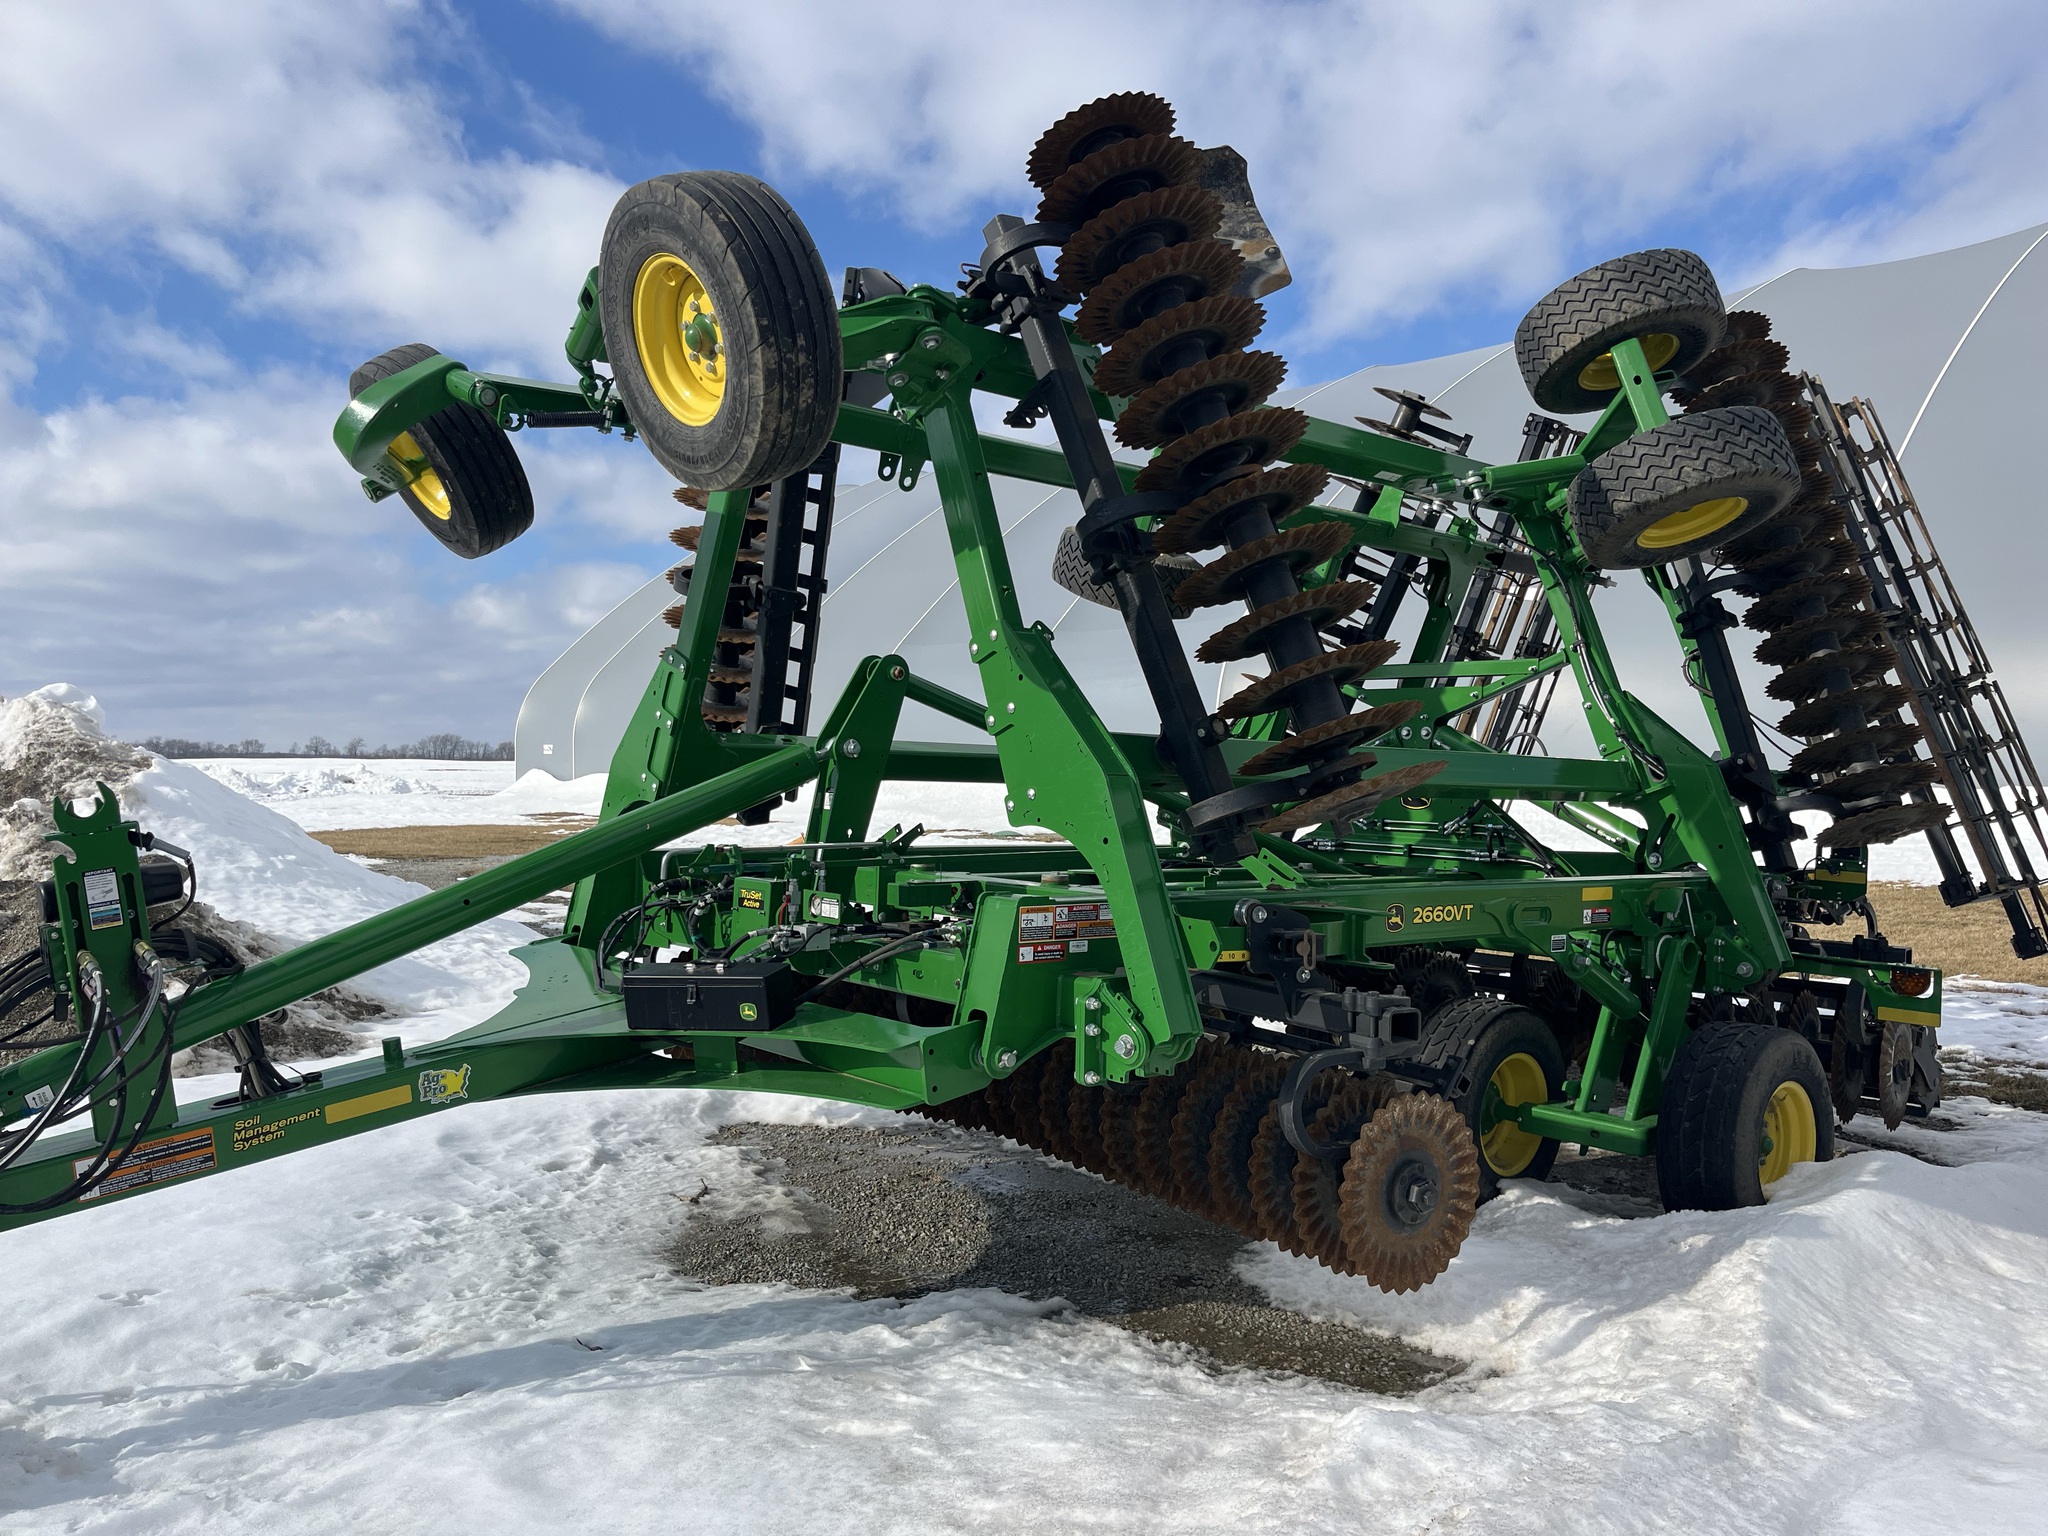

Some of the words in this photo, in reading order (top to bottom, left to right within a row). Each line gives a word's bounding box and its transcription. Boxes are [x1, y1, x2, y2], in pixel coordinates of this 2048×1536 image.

[84, 868, 114, 876] IMPORTANT
[741, 889, 762, 900] TruSet
[743, 899, 760, 909] Active
[1413, 904, 1474, 924] 2660VT
[422, 1073, 446, 1087] Ag-
[422, 1085, 447, 1099] Pro
[233, 1107, 321, 1142] Management
[234, 1114, 260, 1131] Soil
[142, 1137, 175, 1149] WARNING
[233, 1129, 285, 1152] System
[145, 1157, 177, 1170] WARNING
